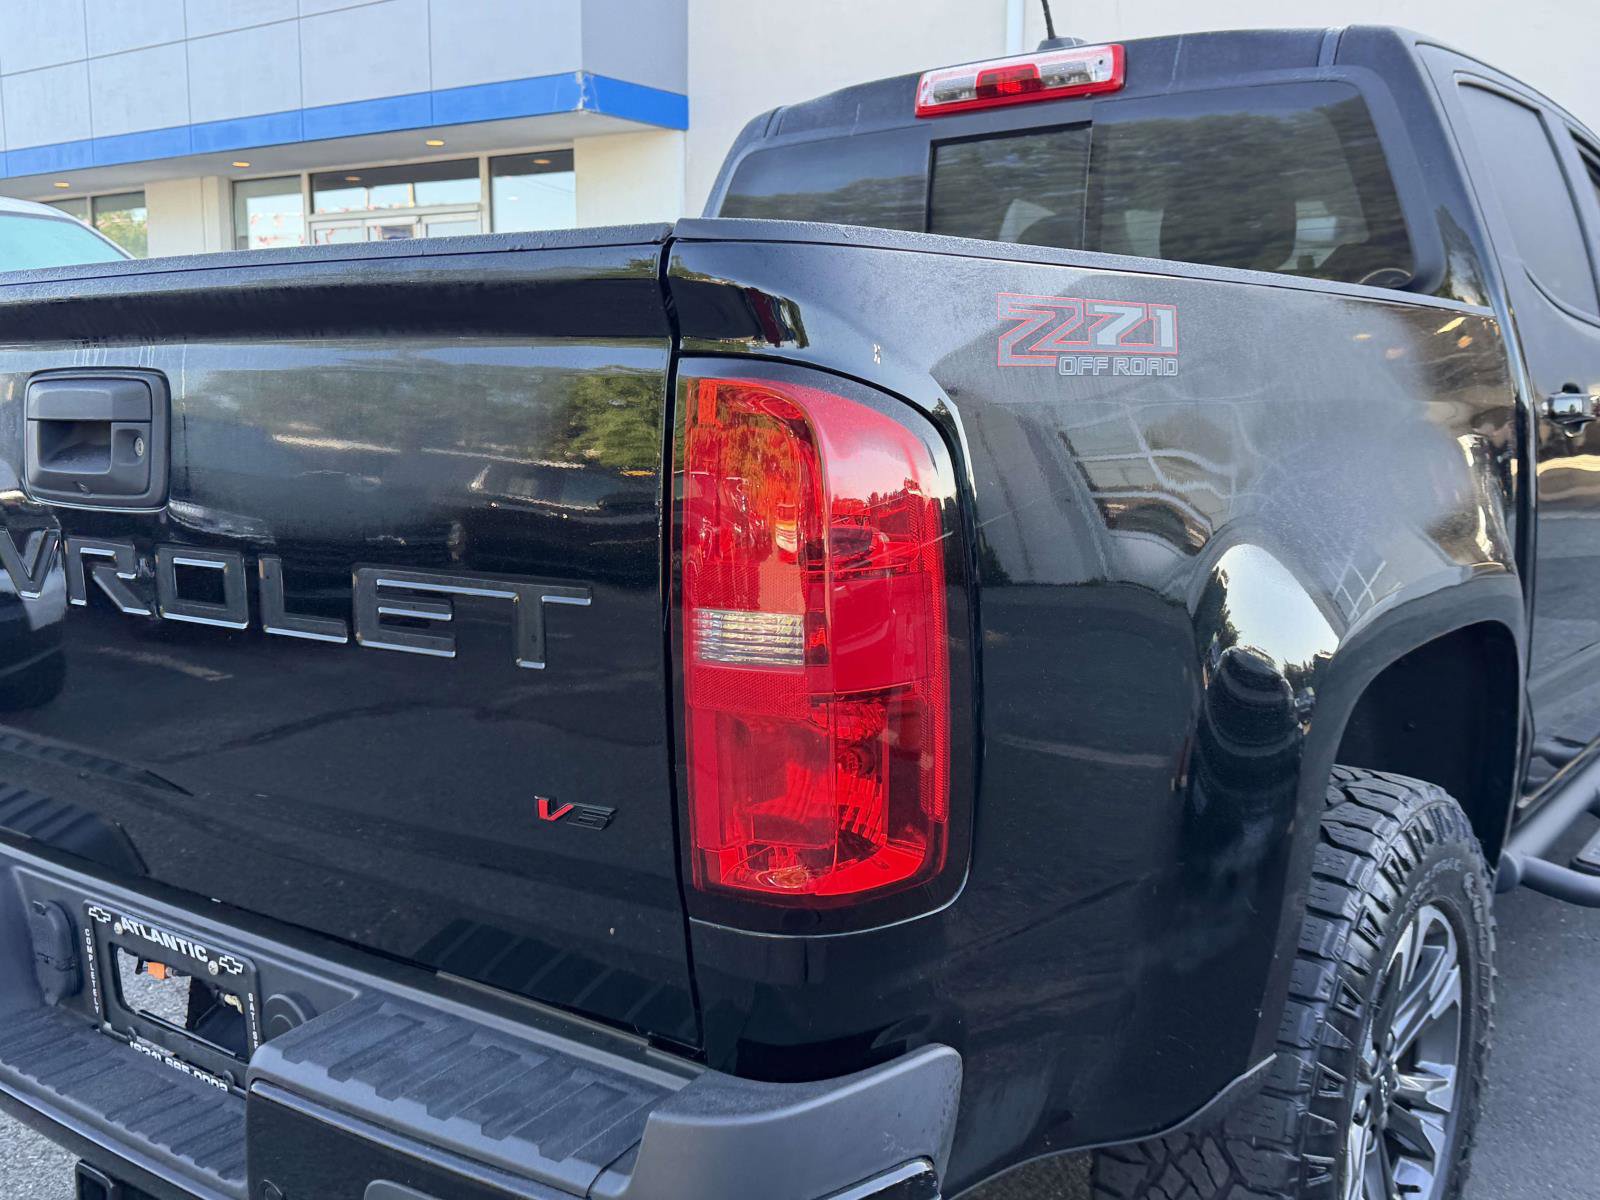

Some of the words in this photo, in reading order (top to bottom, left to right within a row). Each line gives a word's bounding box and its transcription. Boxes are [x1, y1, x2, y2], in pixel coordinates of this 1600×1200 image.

[997, 292, 1178, 367] Z71
[1058, 357, 1108, 376] OFF
[1112, 358, 1178, 376] ROAD
[534, 795, 616, 831] V6
[120, 916, 209, 963] ATLANTIC
[84, 928, 100, 1015] COMPLETELY
